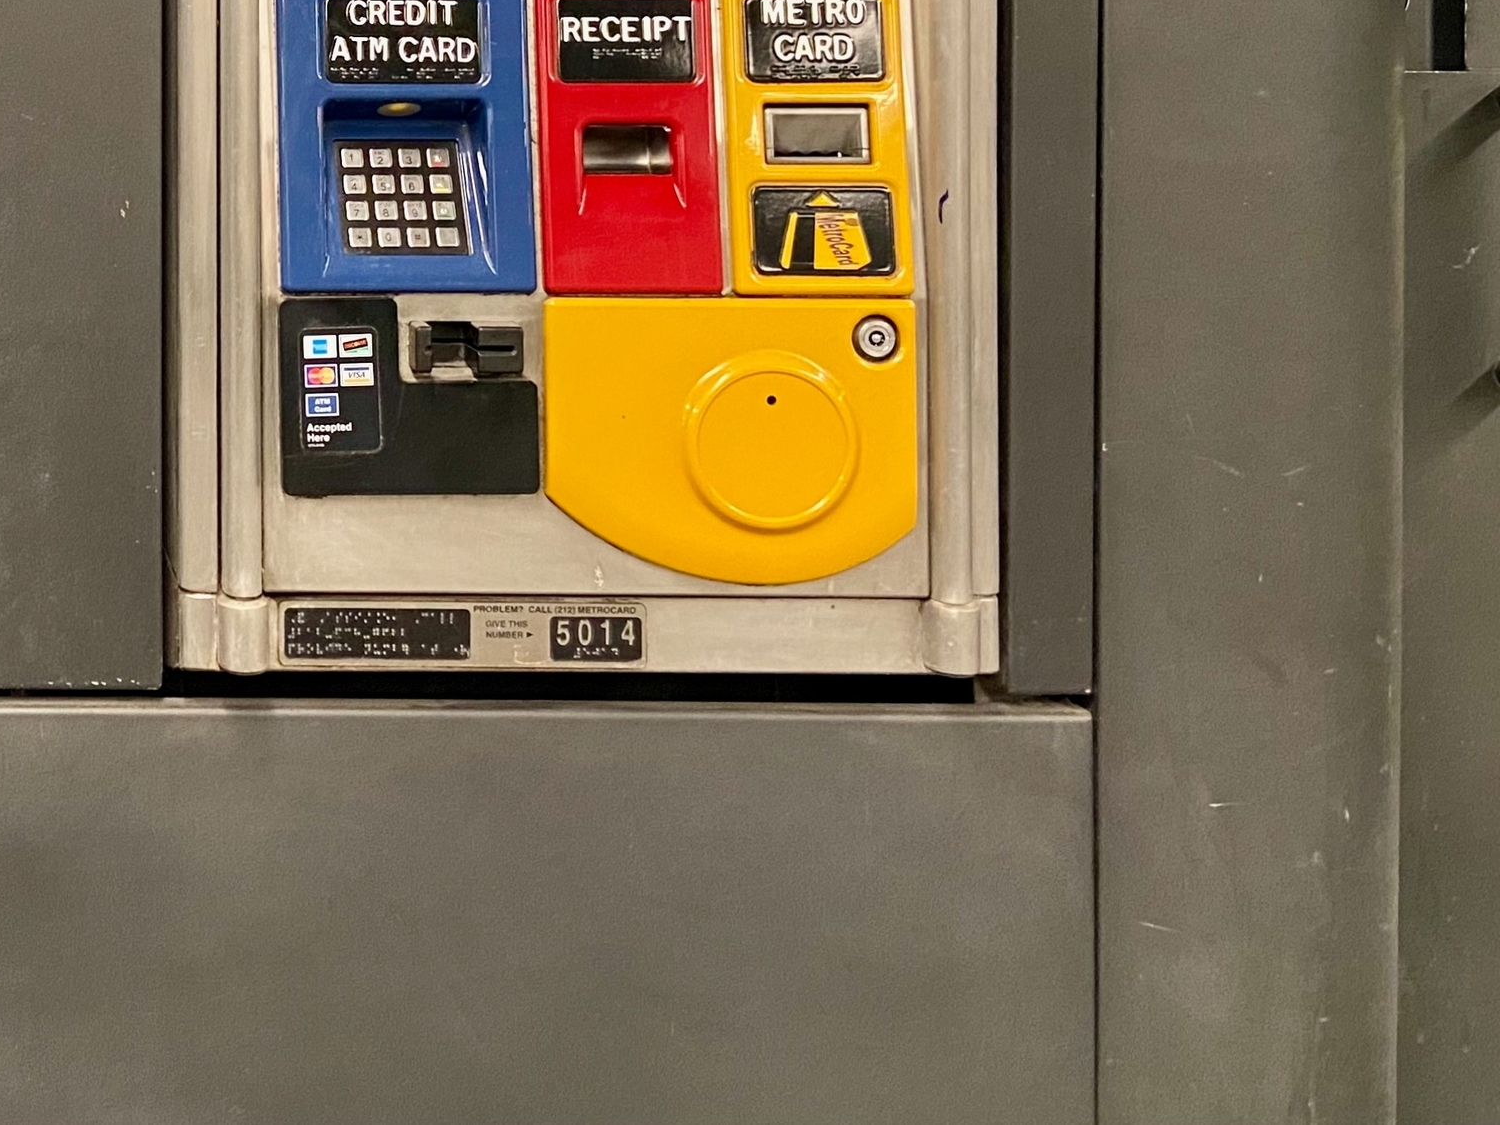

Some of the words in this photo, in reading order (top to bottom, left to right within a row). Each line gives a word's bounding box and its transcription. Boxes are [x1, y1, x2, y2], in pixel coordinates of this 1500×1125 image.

[346, 0, 458, 26] CREDIT
[562, 15, 691, 44] RECEIPT
[329, 35, 389, 62] ATM
[398, 36, 478, 63] CARD
[774, 34, 856, 63] CARD
[377, 157, 384, 165] 2
[407, 157, 414, 165] 3
[351, 183, 358, 191] 4
[381, 183, 387, 191] 5
[409, 183, 415, 191] 6
[354, 209, 360, 217] 7
[383, 209, 390, 217] 8
[412, 209, 418, 217] 9
[385, 233, 392, 241] 0
[816, 215, 859, 265] MetroCard
[348, 371, 366, 379] VISA
[307, 422, 352, 433] Accepted
[307, 433, 330, 442] Here
[473, 605, 523, 613] PROBLEM?
[554, 605, 575, 614] (212)
[578, 606, 636, 614] METROCARD
[485, 620, 506, 628] GIVE
[508, 620, 528, 628] THIS
[556, 619, 635, 645] 5014
